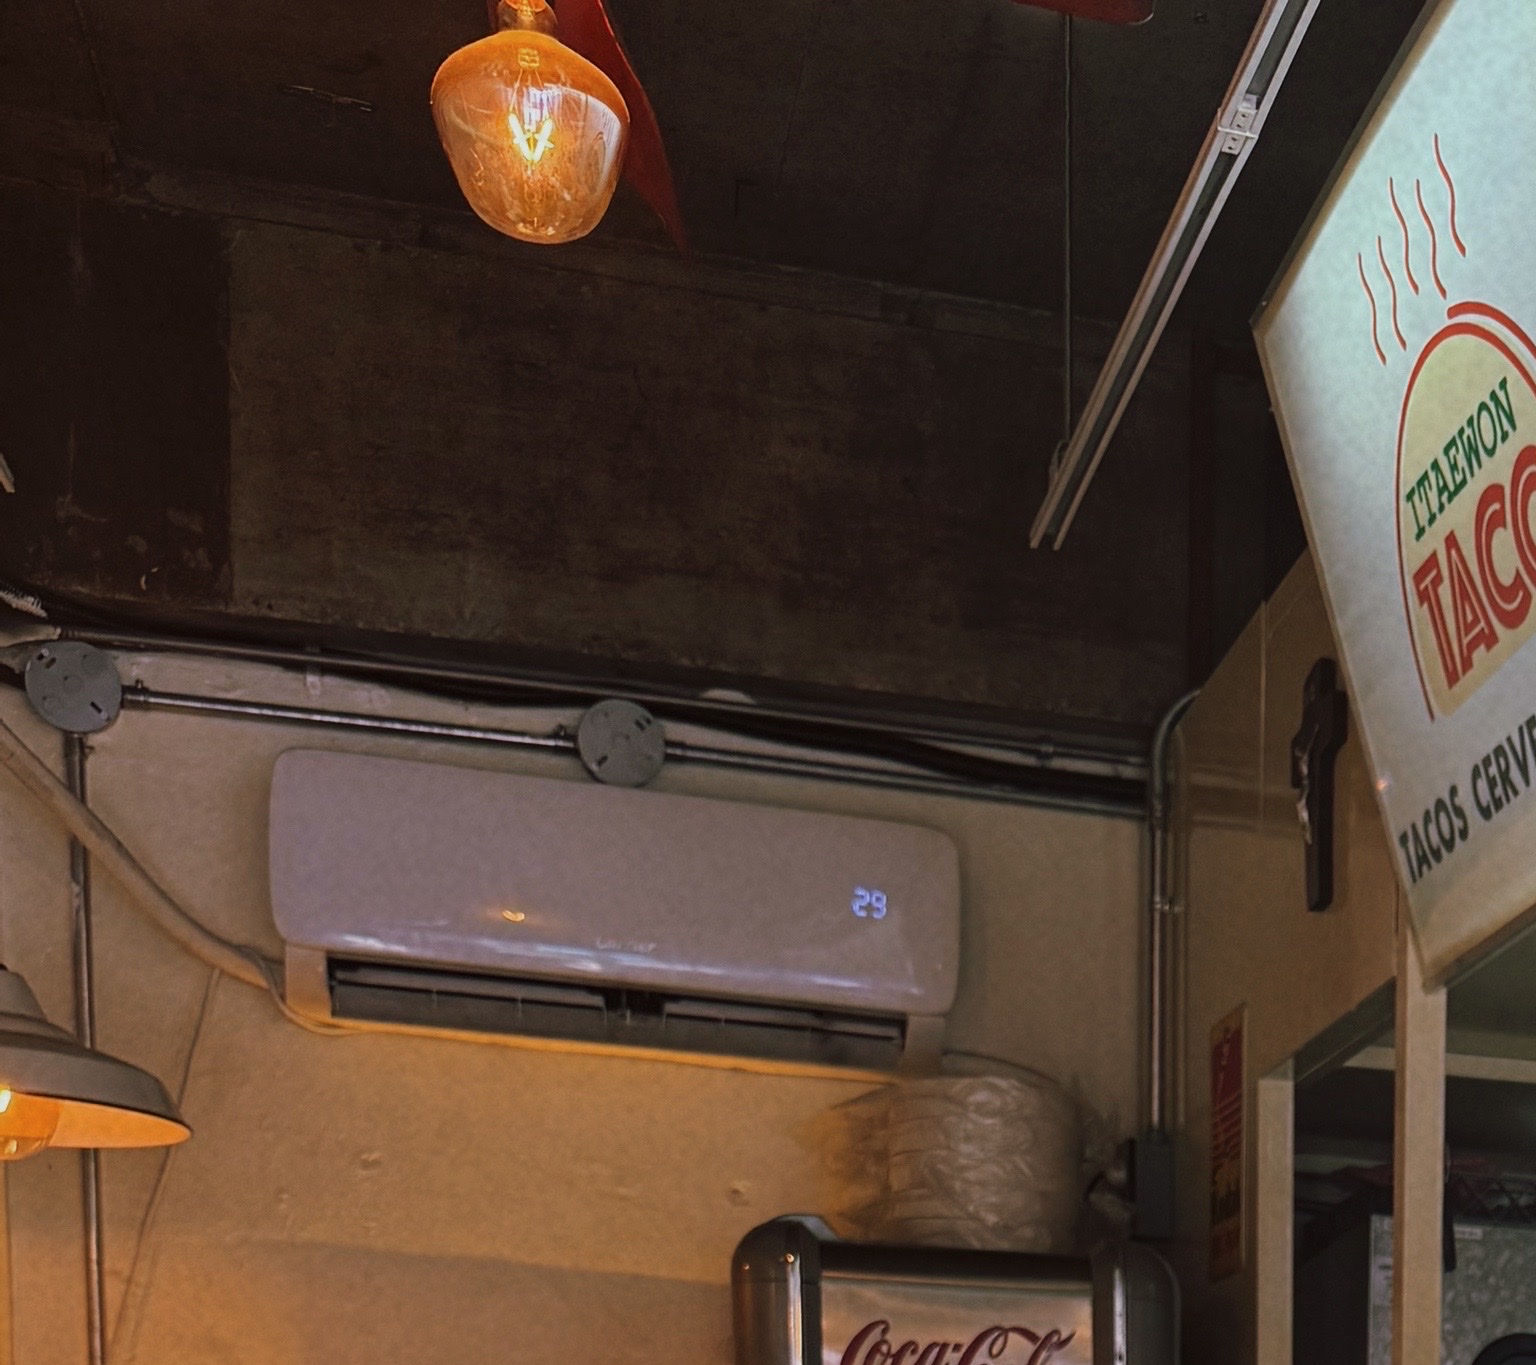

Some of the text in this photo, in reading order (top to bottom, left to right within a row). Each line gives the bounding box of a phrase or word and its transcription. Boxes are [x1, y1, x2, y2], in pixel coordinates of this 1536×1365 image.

[1404, 376, 1520, 543] ITAEWON
[1398, 784, 1471, 884] TACOS
[851, 887, 888, 919] 29
